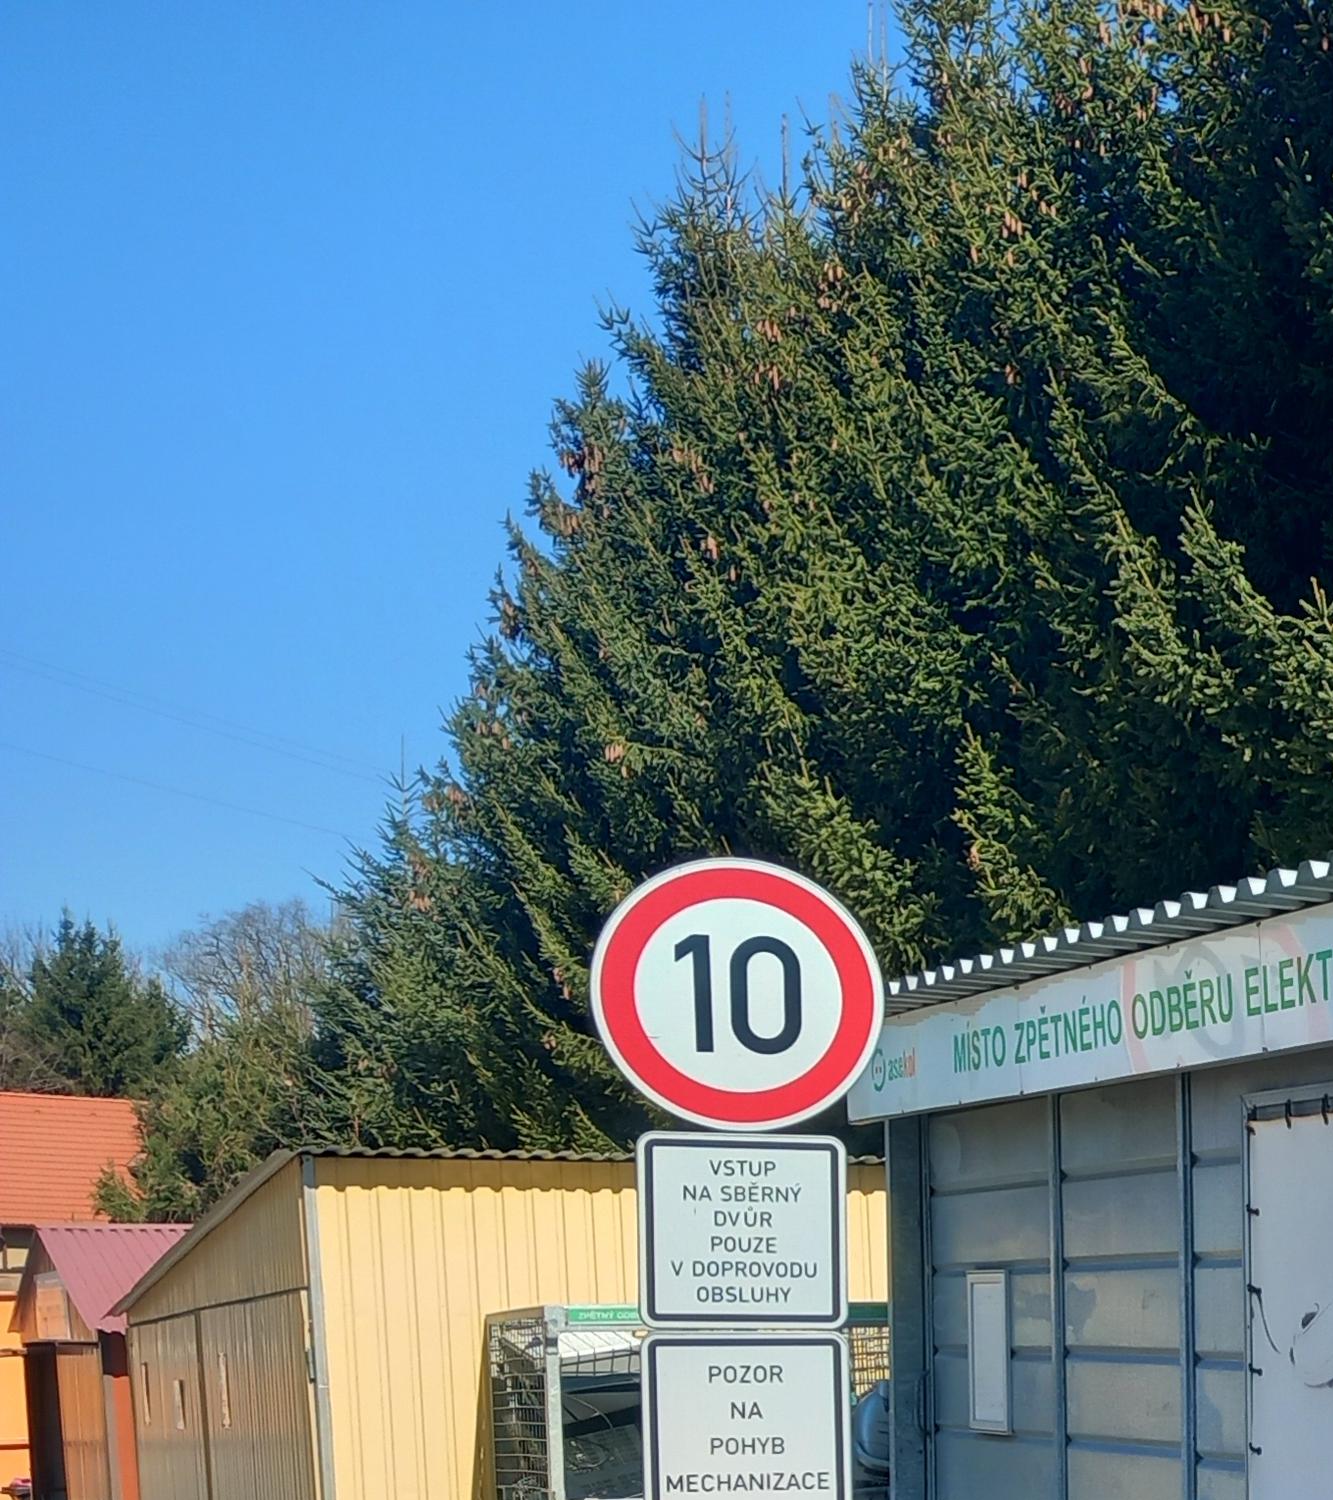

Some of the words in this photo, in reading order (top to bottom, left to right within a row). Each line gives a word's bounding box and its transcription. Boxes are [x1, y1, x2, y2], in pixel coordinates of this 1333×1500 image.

[674, 934, 802, 1055] 10
[953, 1020, 1006, 1074] MÍSTO
[1014, 995, 1122, 1065] ZPĚTNÉHO
[1131, 970, 1233, 1040] ODBĚRU
[888, 1047, 917, 1081] asekol
[709, 1160, 776, 1177] VSTUP
[682, 1185, 712, 1201] NA
[720, 1181, 801, 1203] SBĚRNÝ
[713, 1206, 772, 1228] DVŮR
[710, 1236, 777, 1254] POUZE
[670, 1260, 684, 1277] V
[692, 1260, 818, 1279] DOPROVODU
[696, 1286, 791, 1303] OBSLUHY
[708, 1365, 784, 1384] POZOR
[730, 1402, 763, 1420] NA
[710, 1437, 785, 1455] POHYB
[666, 1472, 830, 1493] MECHANIZACE
